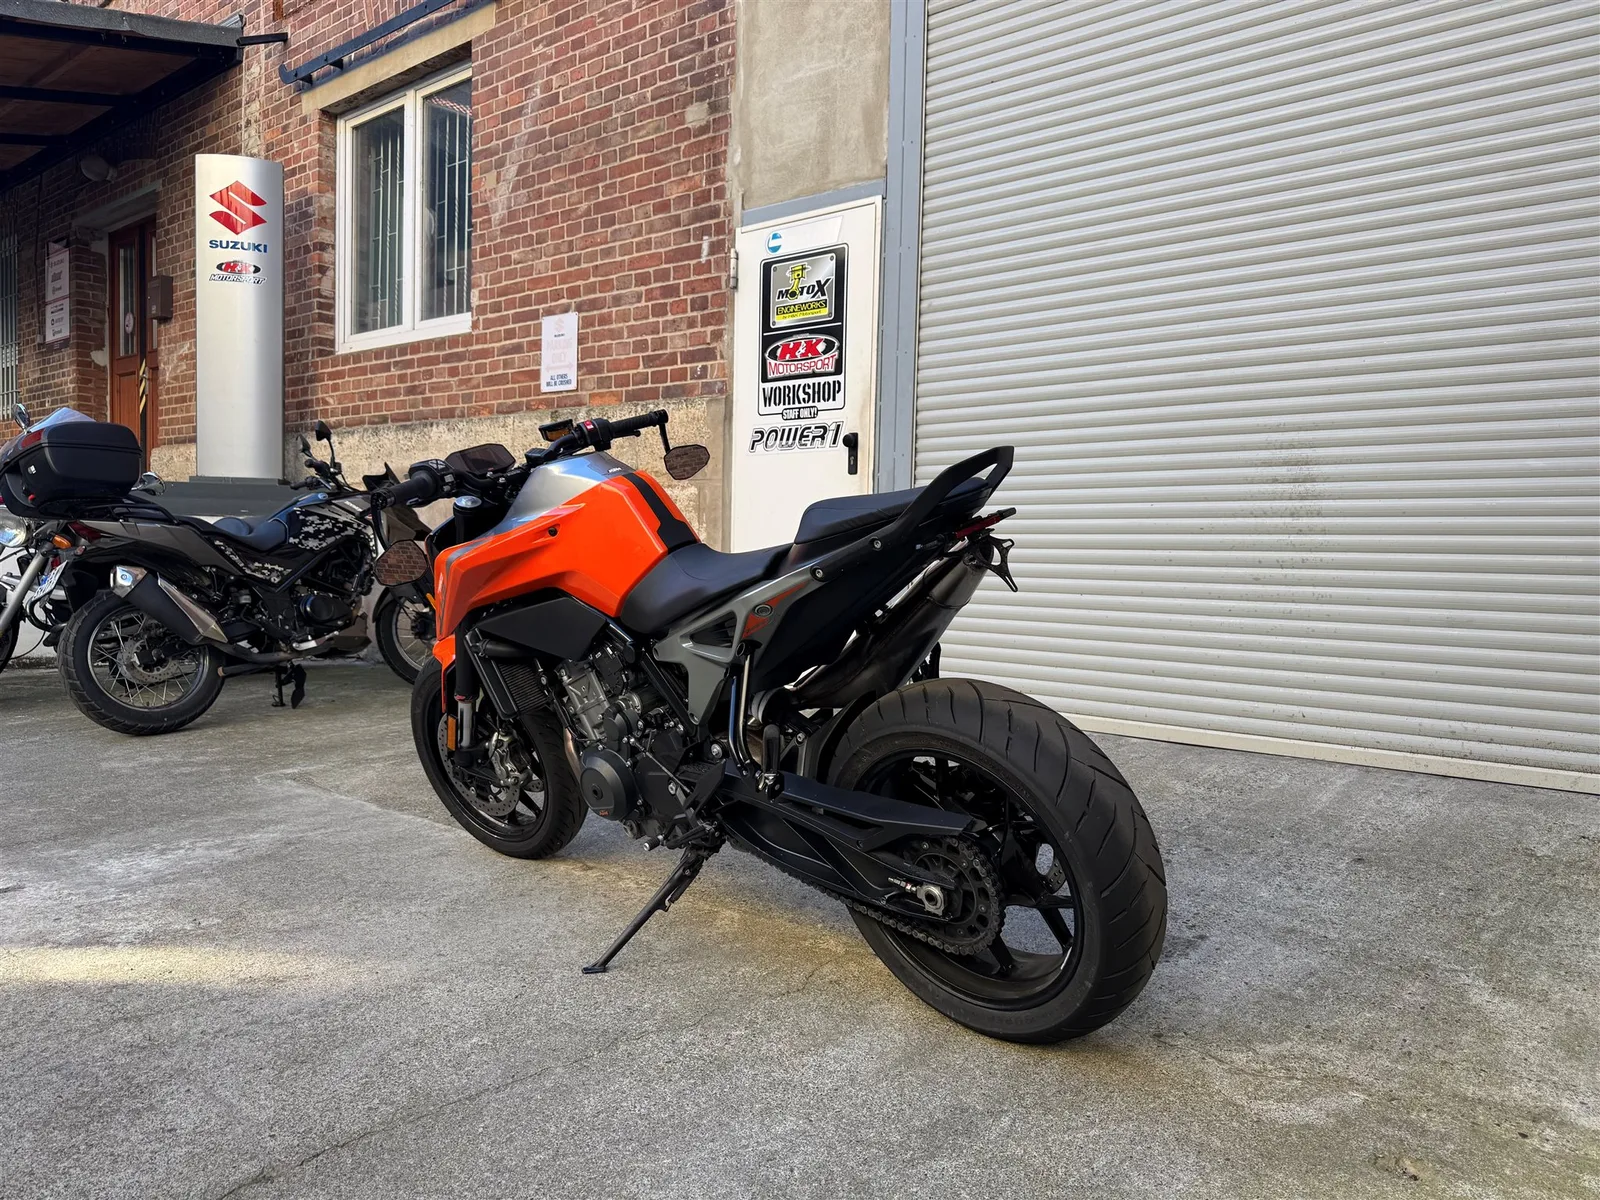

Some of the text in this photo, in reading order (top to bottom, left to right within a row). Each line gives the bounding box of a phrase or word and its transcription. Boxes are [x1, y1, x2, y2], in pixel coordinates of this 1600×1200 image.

[209, 239, 268, 254] SUZUKI
[777, 300, 826, 315] ENGINEWORKS
[768, 354, 837, 376] MOTORSPORT
[762, 380, 842, 408] WORKSHOP
[783, 407, 818, 419] STAFF ONLY!
[749, 421, 844, 453] POWER1
